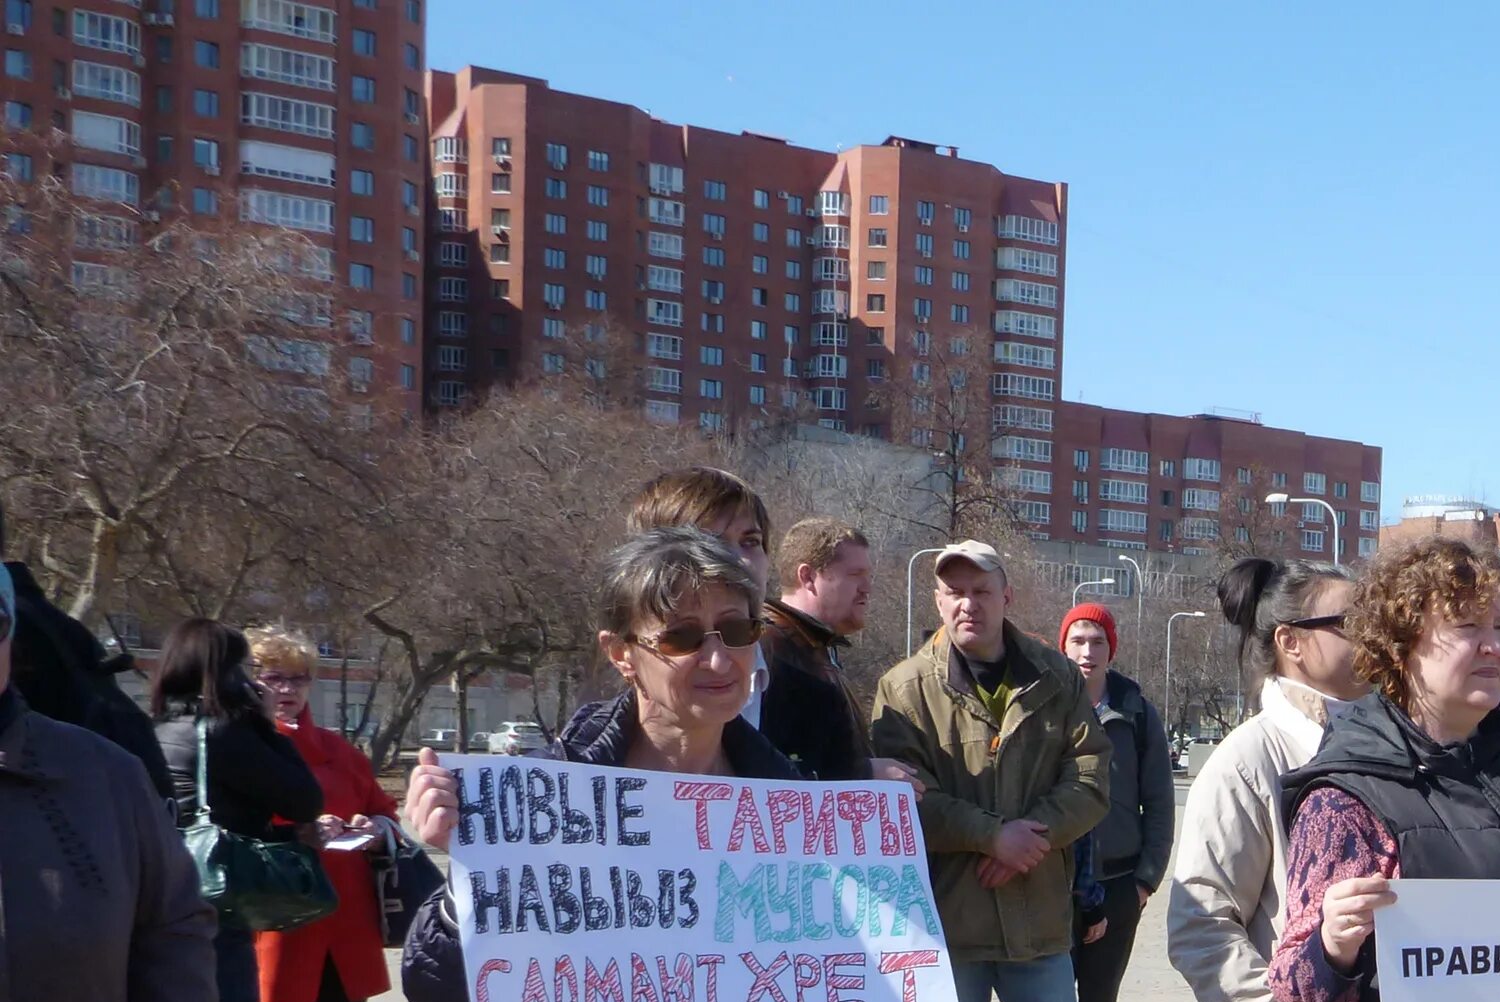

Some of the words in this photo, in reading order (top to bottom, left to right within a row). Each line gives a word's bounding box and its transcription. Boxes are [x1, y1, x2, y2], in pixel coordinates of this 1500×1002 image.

[451, 765, 651, 846] НОВЫЕ
[673, 781, 916, 856] ТАРИФЫ
[715, 860, 938, 942] МУСОРА
